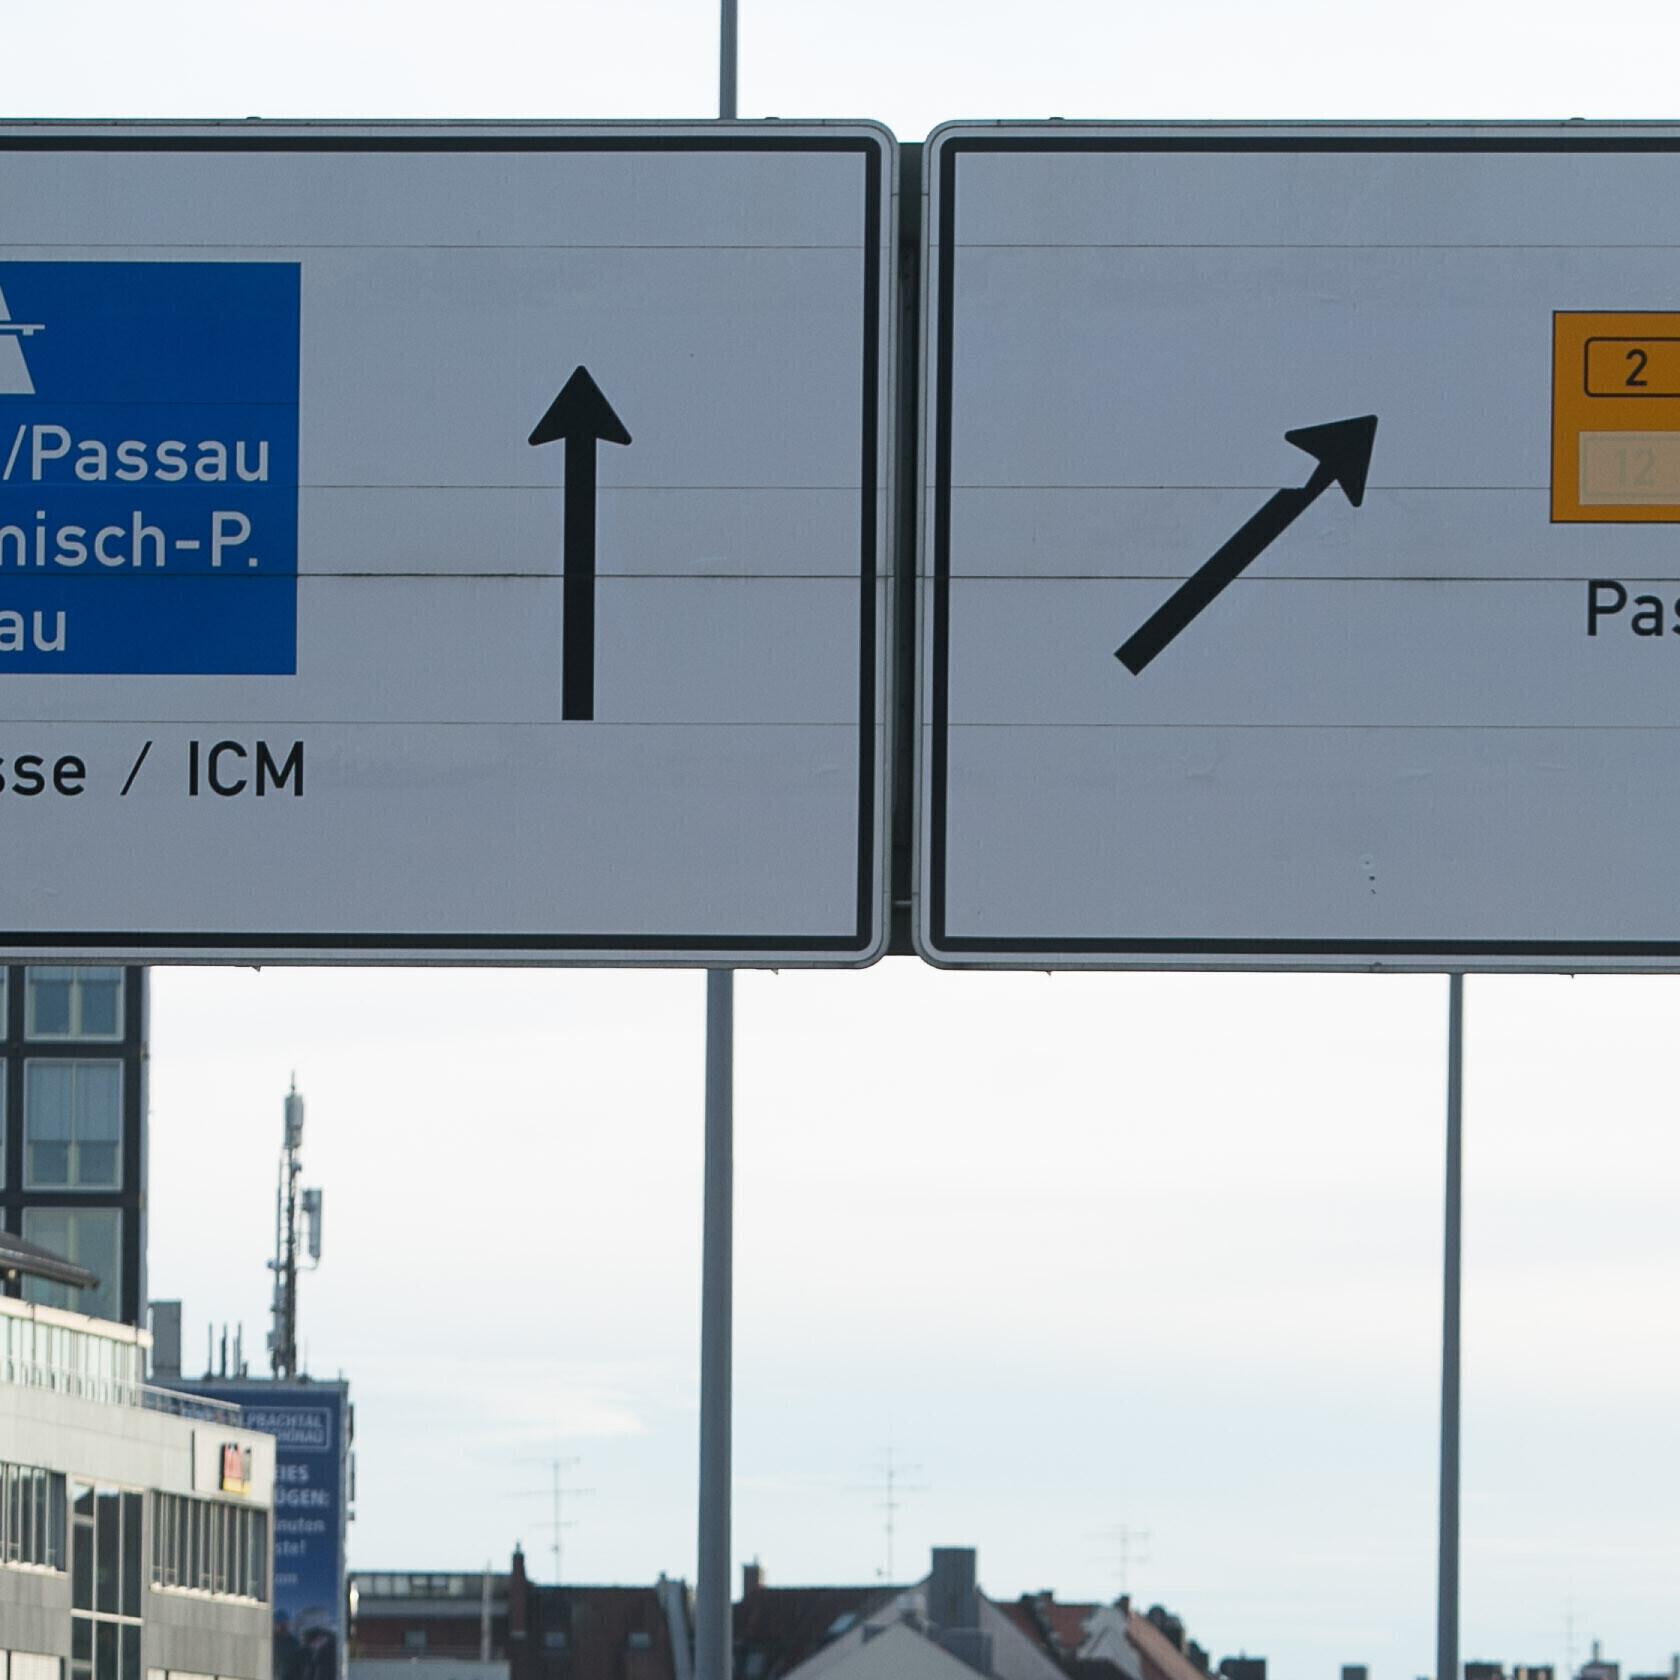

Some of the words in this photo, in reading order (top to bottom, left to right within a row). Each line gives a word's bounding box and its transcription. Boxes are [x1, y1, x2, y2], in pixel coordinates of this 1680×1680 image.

[1625, 349, 1648, 386] 2
[120, 741, 153, 796] /
[189, 741, 305, 797] ICM
